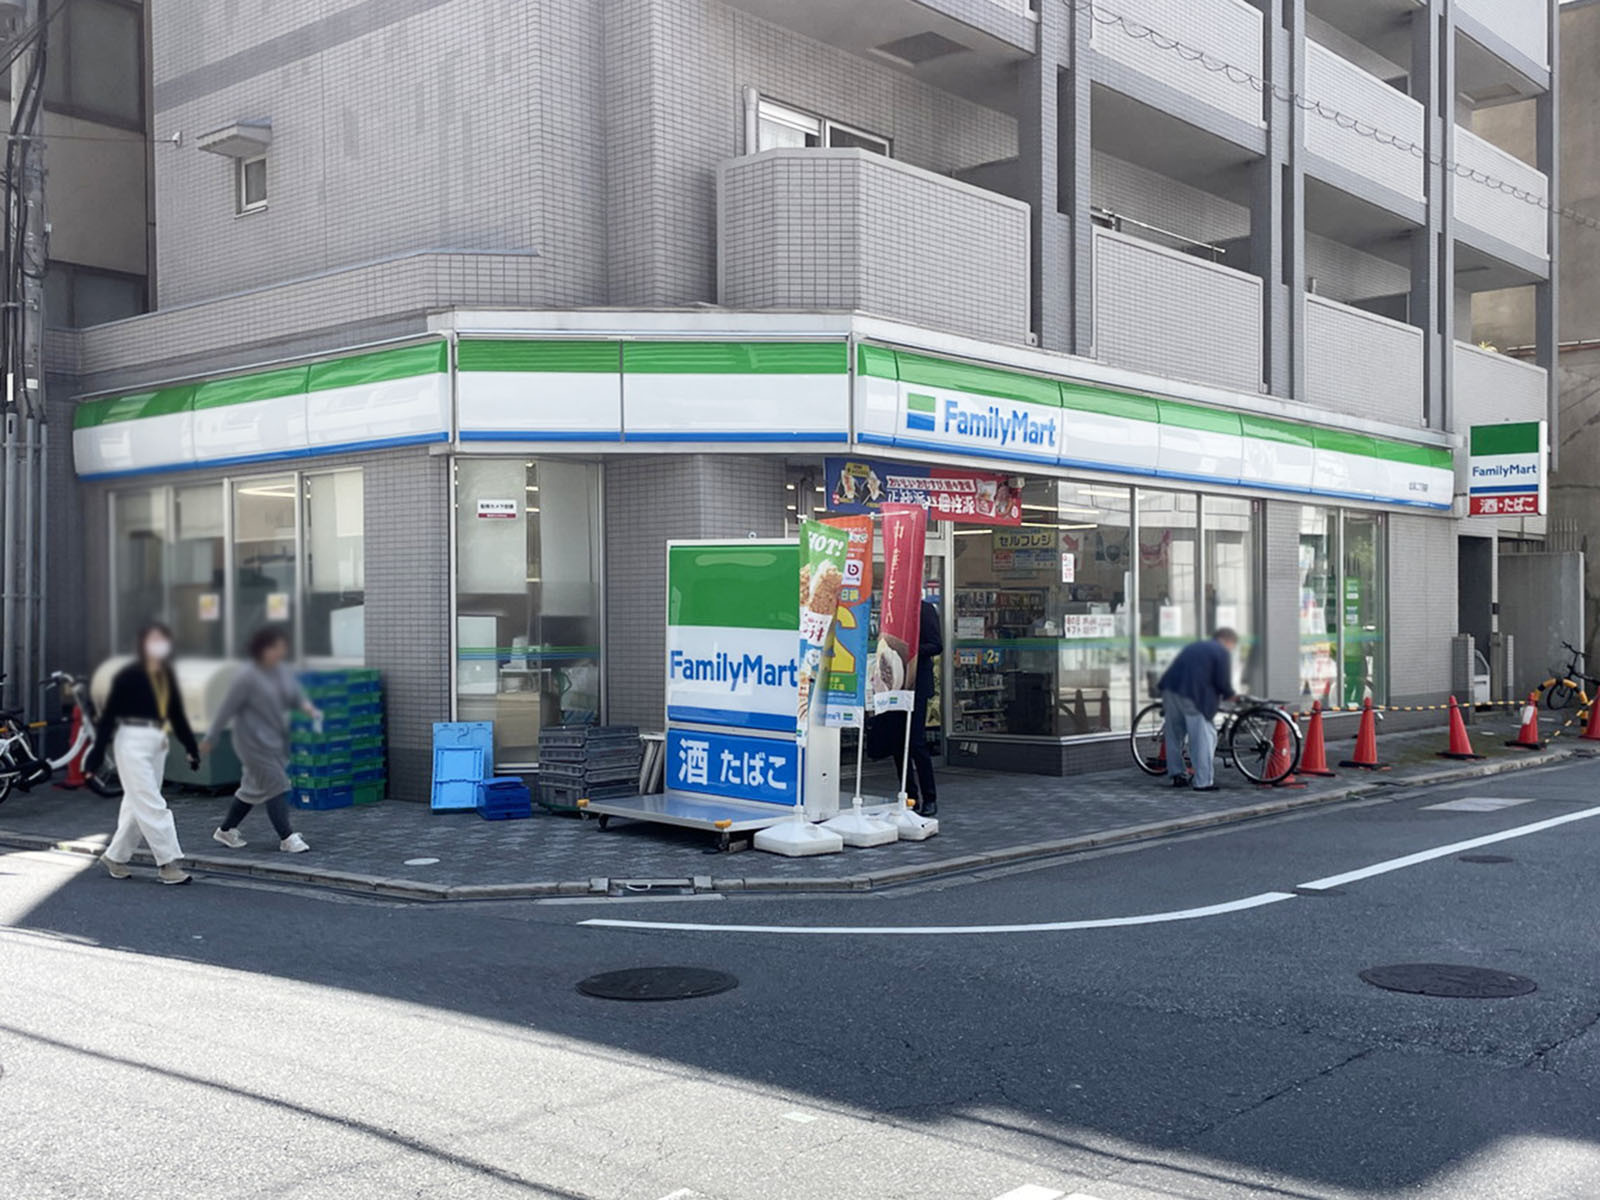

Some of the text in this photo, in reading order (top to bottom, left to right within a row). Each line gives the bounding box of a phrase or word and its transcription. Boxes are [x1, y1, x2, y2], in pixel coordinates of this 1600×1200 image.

[944, 400, 1056, 447] FamilyMart
[1472, 464, 1537, 477] FamilyMart
[1480, 497, 1535, 513] 酒・たばこ
[999, 534, 1052, 547] セルフレジ
[670, 650, 798, 692] FamilyMart
[678, 738, 787, 790] 酒 たばこ
